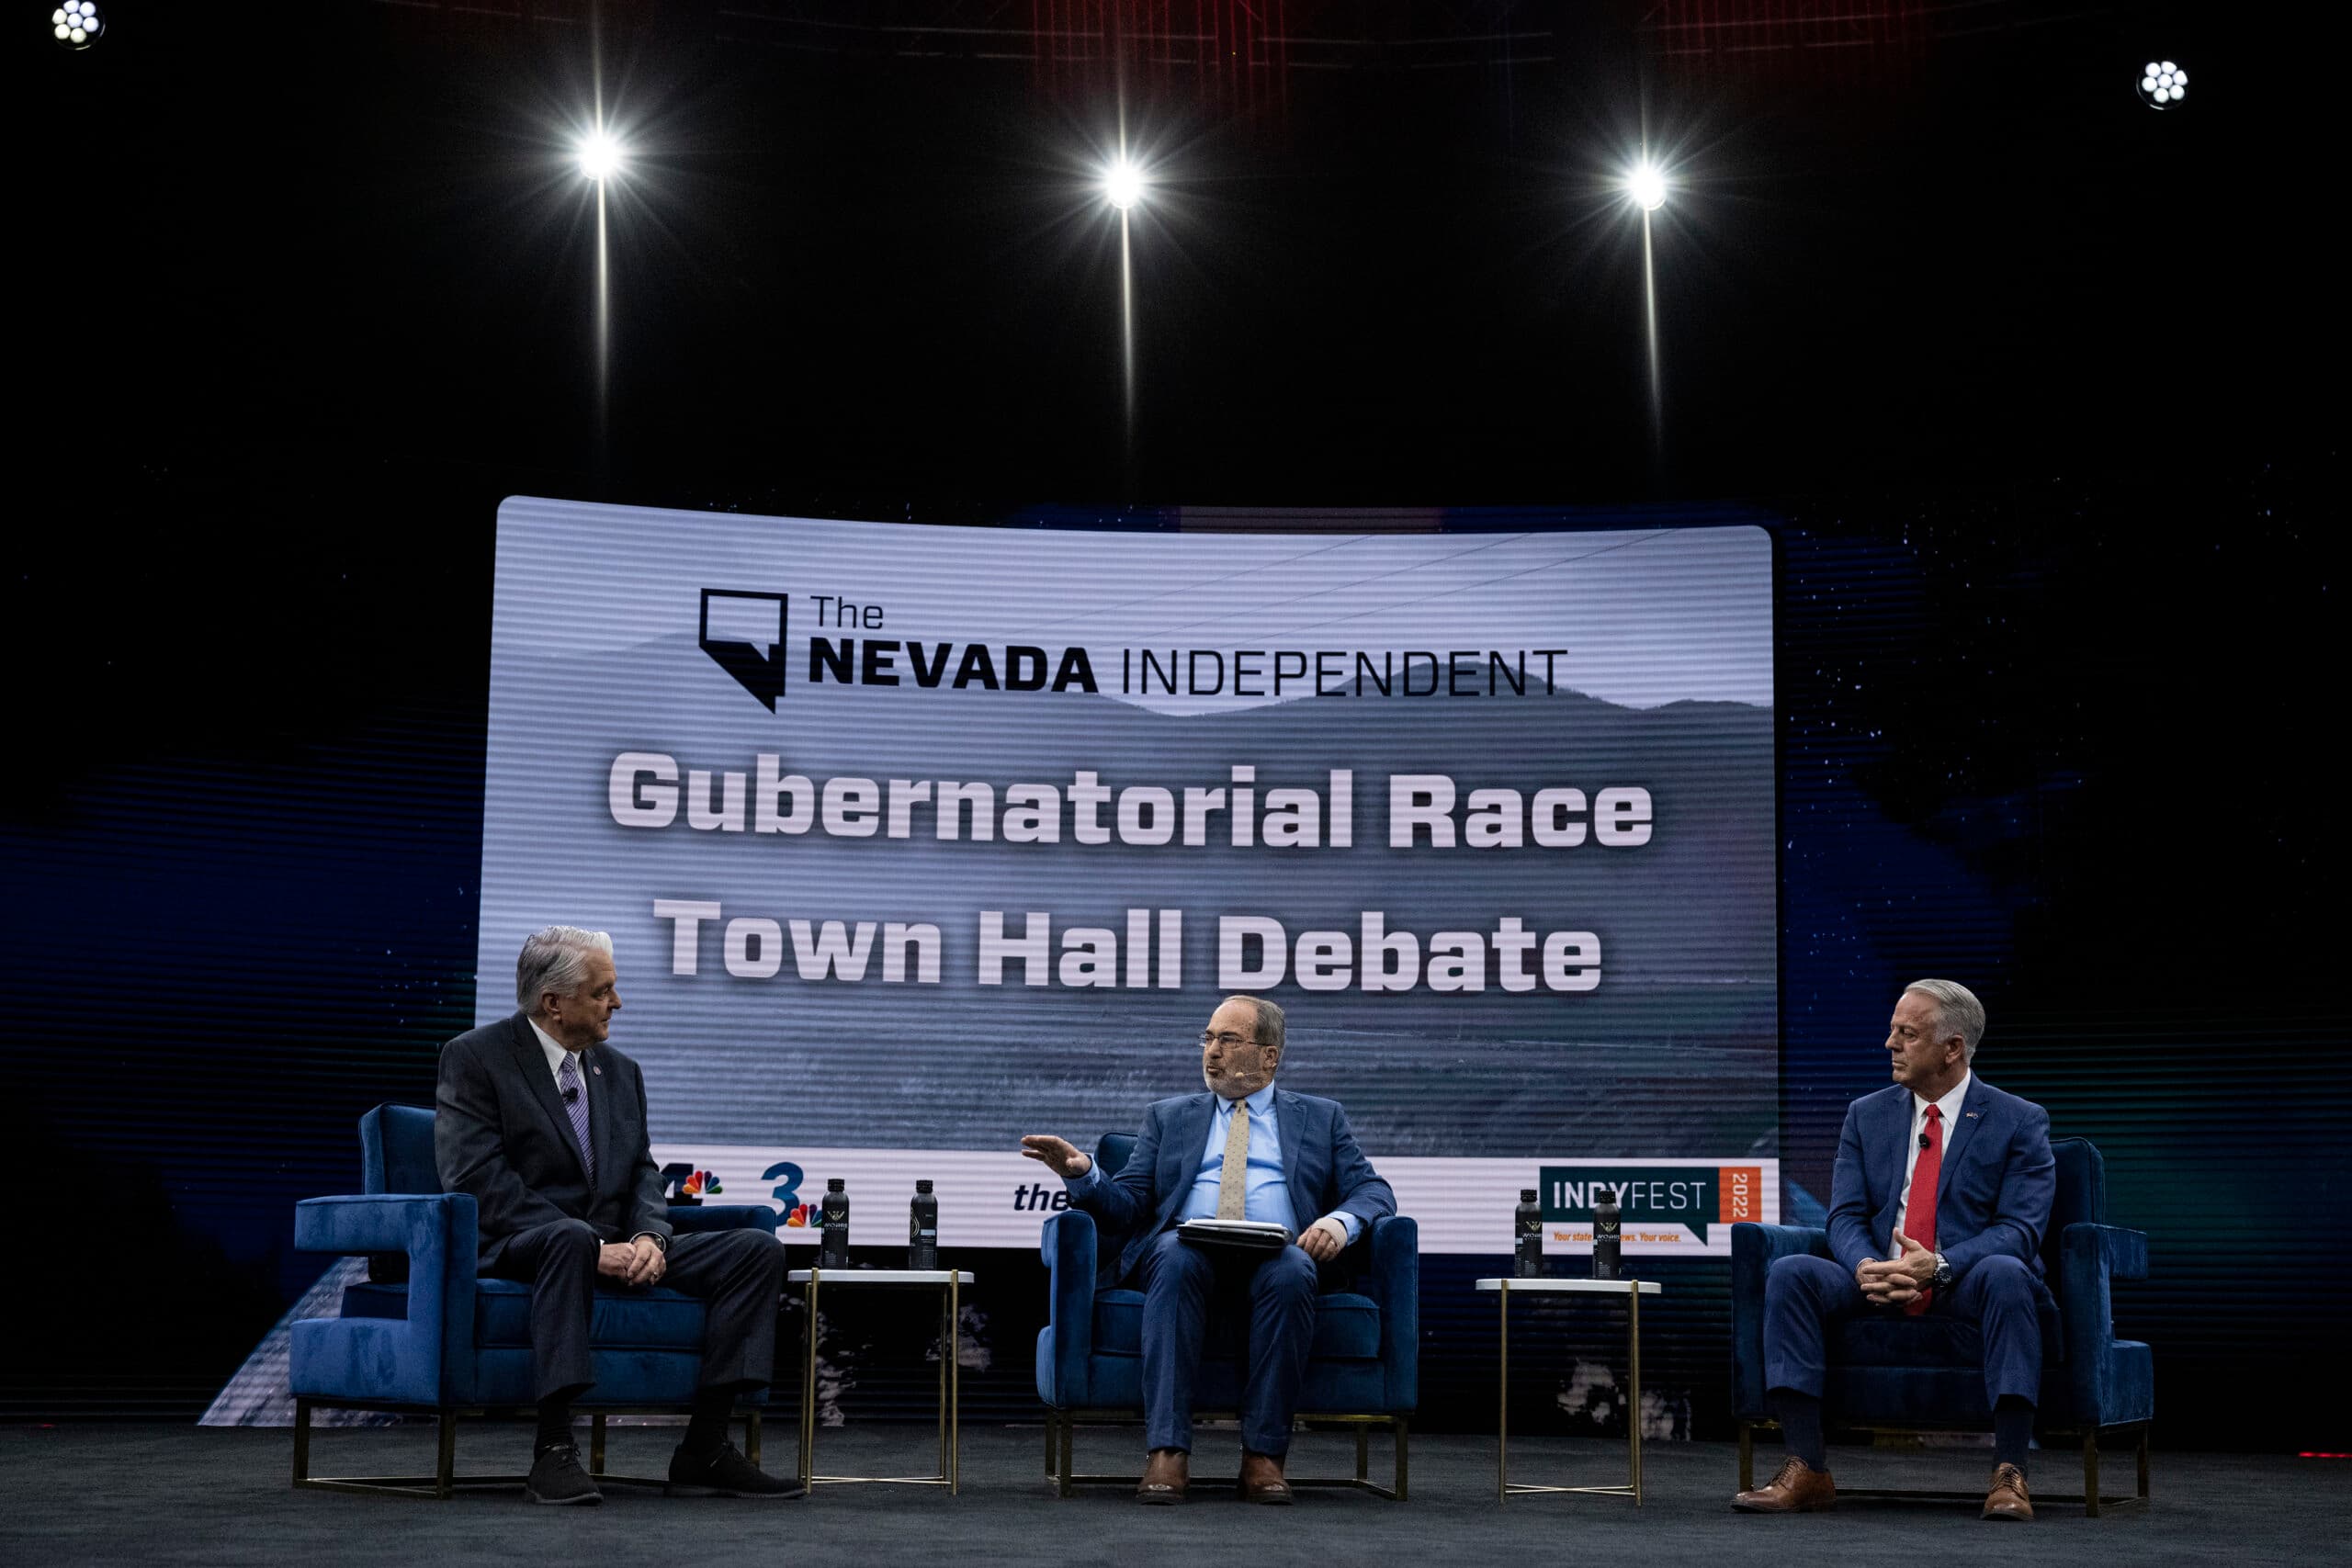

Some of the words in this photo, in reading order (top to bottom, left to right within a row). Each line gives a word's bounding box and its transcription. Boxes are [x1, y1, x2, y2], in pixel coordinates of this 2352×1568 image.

[810, 595, 884, 629] The
[808, 637, 1099, 694] NEVADA
[1123, 648, 1568, 696] INDEPENDENT
[608, 751, 1352, 848] Gubernatorial
[1389, 774, 1652, 848] Race
[653, 898, 942, 984] Town
[978, 908, 1182, 989] Hall
[1218, 910, 1602, 992] Debate
[761, 1161, 804, 1226] 3
[1014, 1183, 1069, 1211] the
[1554, 1181, 1706, 1210] INDYFEST
[1732, 1173, 1748, 1218] 2022
[1554, 1231, 1571, 1241] Your
[1640, 1233, 1657, 1242] Your
